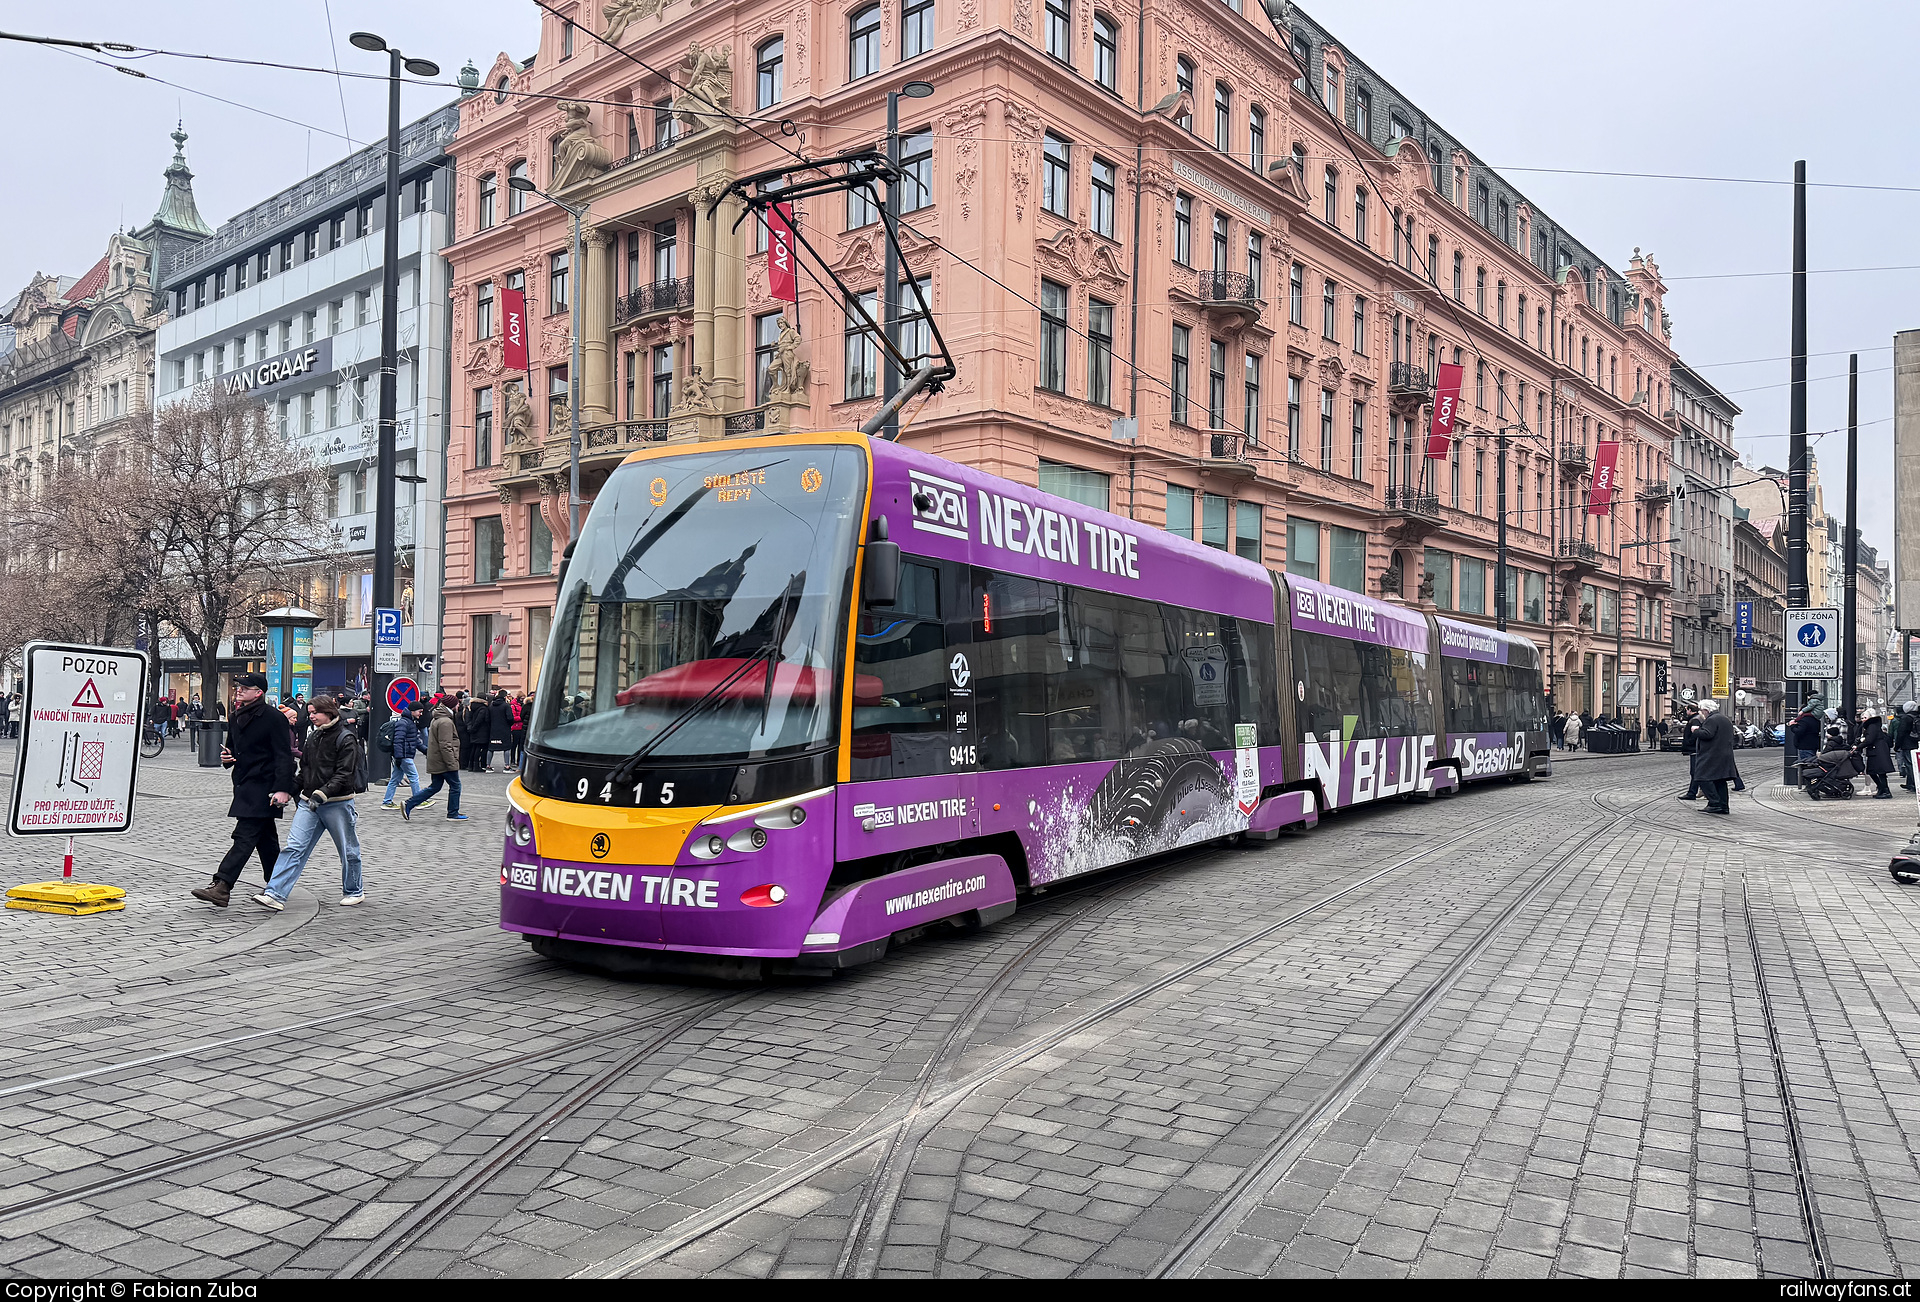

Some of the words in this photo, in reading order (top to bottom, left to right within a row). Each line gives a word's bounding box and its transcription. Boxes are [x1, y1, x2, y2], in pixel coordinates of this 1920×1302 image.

[1177, 163, 1233, 203] ASSICURAZIONI
[1234, 194, 1267, 221] GENERALI
[774, 229, 789, 272] AON
[508, 312, 521, 347] AON
[223, 369, 254, 396] VAN
[257, 348, 315, 386] GRAAF
[1438, 396, 1453, 427] AON
[703, 469, 766, 489] SÍDLIŠTĚ
[1597, 466, 1611, 489] AON
[650, 477, 667, 507] 9
[717, 487, 752, 502] ŘEPY
[910, 481, 968, 529] NEXEN
[978, 490, 1079, 566] NEXEN
[1084, 521, 1140, 580] TIRE
[381, 613, 397, 634] P
[1317, 592, 1353, 628] NEXEN
[1355, 603, 1376, 632] TIRE
[1790, 612, 1809, 620] PĚŠÍ
[1811, 612, 1834, 620] ZÓNA
[238, 639, 256, 652] VAN
[1442, 626, 1469, 648] Celoroční
[1469, 635, 1498, 658] pneumatiky
[62, 656, 118, 676] POZOR
[33, 708, 70, 723] VÁNOČNÍ
[71, 712, 91, 723] TRHY
[93, 715, 98, 723] a
[100, 711, 136, 725] KLUZIŠTĚ
[955, 711, 968, 727] pid
[950, 745, 976, 766] 9415
[34, 800, 50, 812] PRO
[53, 798, 89, 812] PRŮJEZD
[90, 798, 116, 811] UŽIJTE
[897, 801, 939, 824] NEXEN
[940, 799, 967, 818] TIRE
[22, 812, 60, 825] VEDLEJŠÍ
[62, 810, 107, 824] POJEZDOVÝ
[108, 811, 124, 823] PÁS
[511, 867, 537, 886] NEXEN
[542, 866, 633, 902] NEXEN
[640, 875, 720, 908] TIRE
[885, 874, 986, 916] www.nexentire.com
